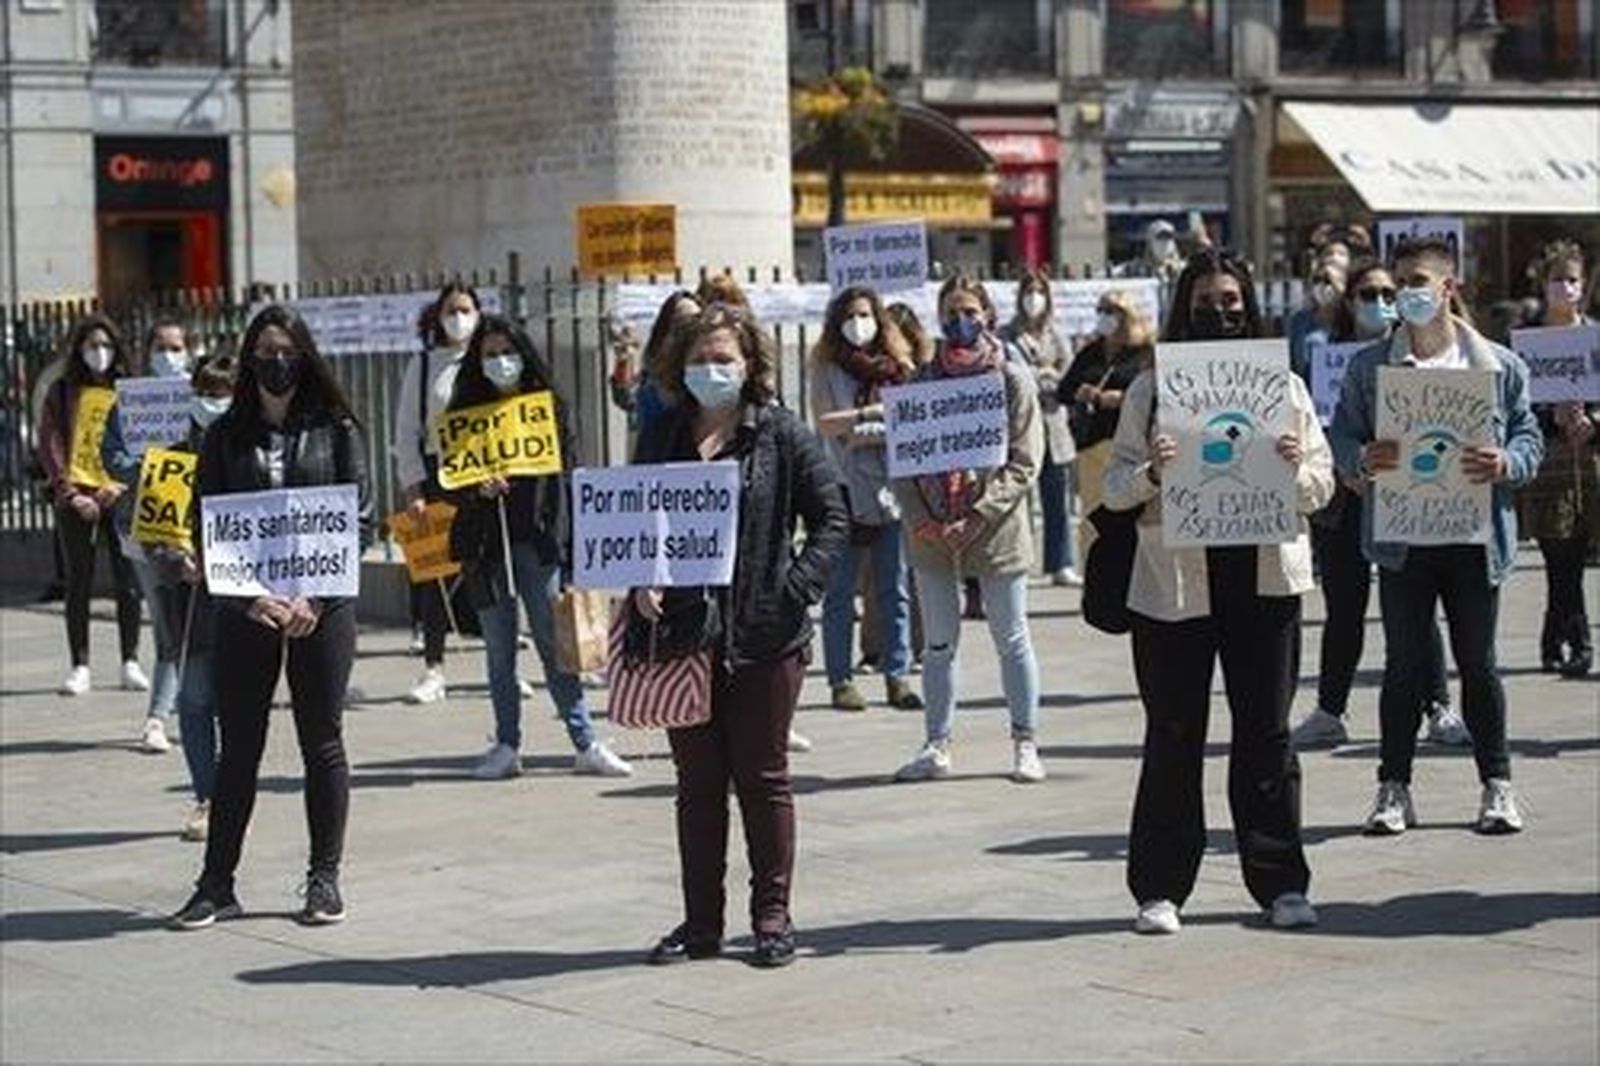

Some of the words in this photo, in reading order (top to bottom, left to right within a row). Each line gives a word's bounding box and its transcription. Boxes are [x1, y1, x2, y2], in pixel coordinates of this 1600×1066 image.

[108, 154, 212, 187] Orange
[829, 235, 850, 254] Por
[873, 230, 922, 253] derecho
[836, 268, 843, 287] y
[847, 266, 867, 285] por
[438, 412, 507, 450] ¡Por
[520, 403, 550, 424] la
[443, 434, 555, 473] SALUD!
[896, 431, 937, 464] mejor
[581, 483, 613, 514] Por
[619, 481, 644, 513] mi
[648, 479, 731, 512] derecho
[207, 510, 253, 550] ¡Más
[257, 504, 348, 540] sanitarios
[211, 555, 265, 588] mejor
[268, 547, 349, 582] tratados!
[584, 538, 597, 571] y
[601, 536, 635, 569] por
[640, 531, 657, 560] tu
[664, 528, 724, 560] salud.
